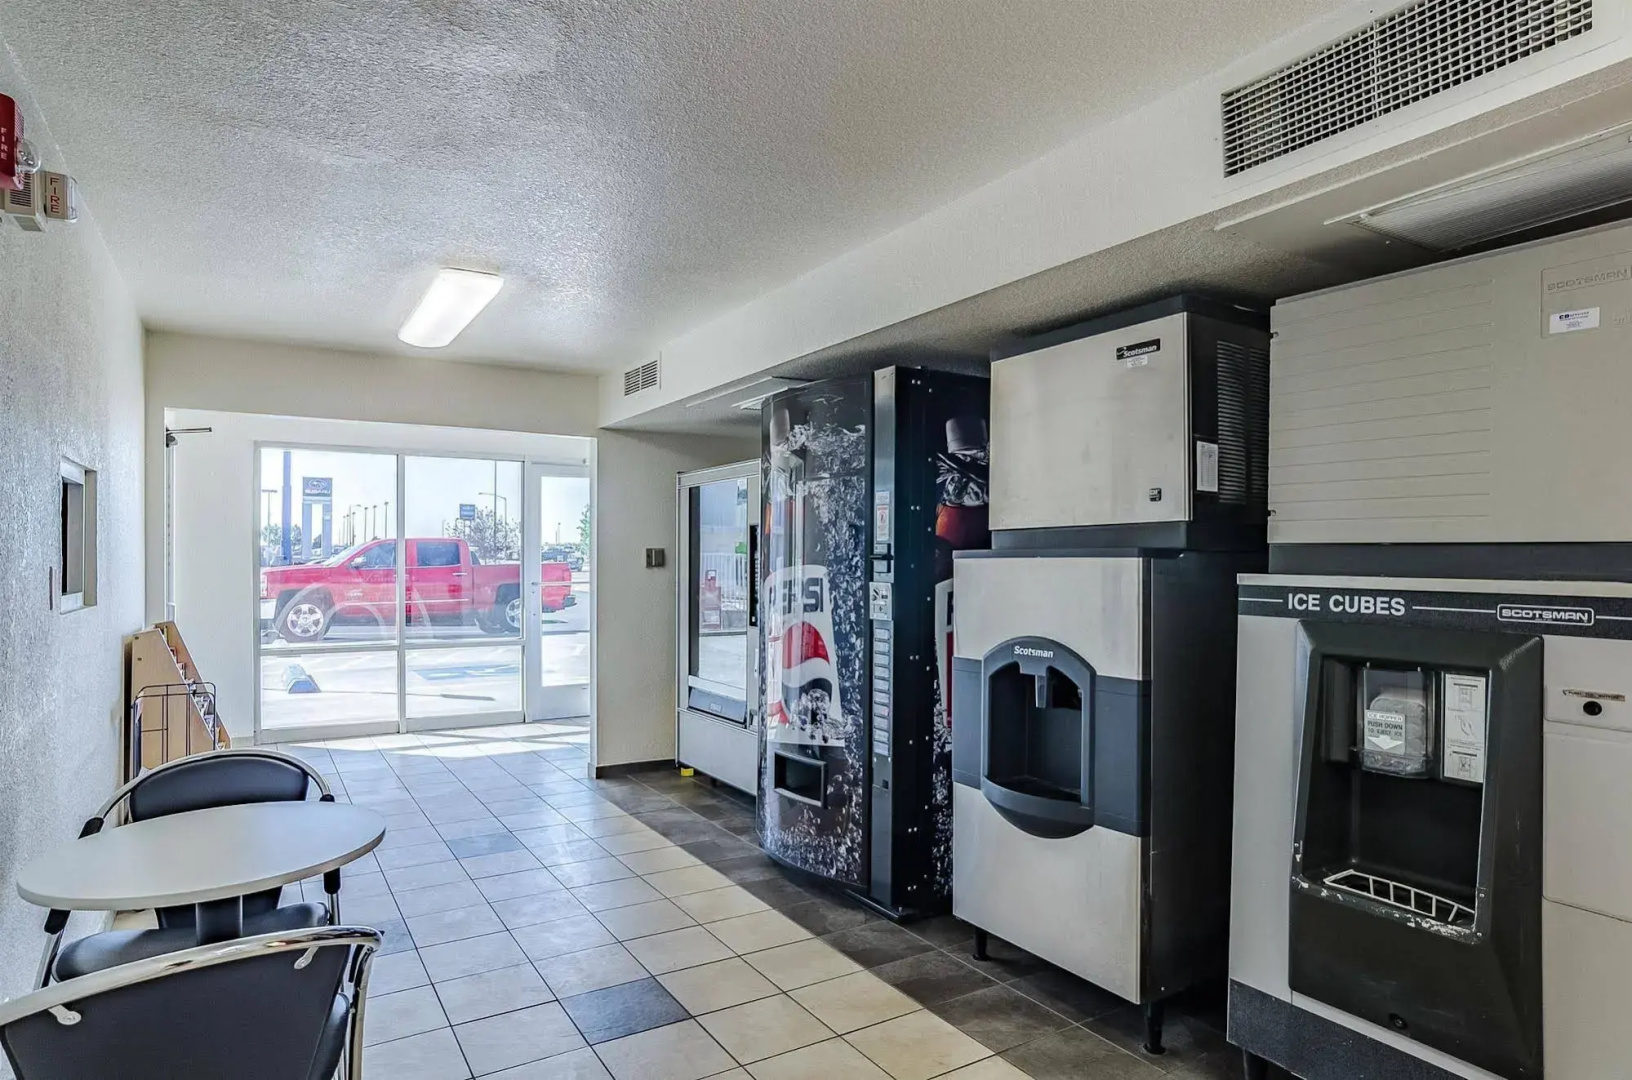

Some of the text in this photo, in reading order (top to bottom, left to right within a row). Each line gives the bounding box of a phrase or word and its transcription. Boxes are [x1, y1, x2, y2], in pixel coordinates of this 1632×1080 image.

[0, 127, 8, 160] FIRE
[50, 177, 60, 213] FIRE
[1547, 268, 1628, 291] SCOTSMAN
[1123, 345, 1157, 358] Scotsman
[769, 577, 824, 615] PEPSI
[1288, 593, 1406, 616] ICE CUBES
[1501, 608, 1588, 621] SCOTSMAN
[1013, 645, 1054, 658] Scotsman
[1367, 720, 1403, 730] PUSH DOWN
